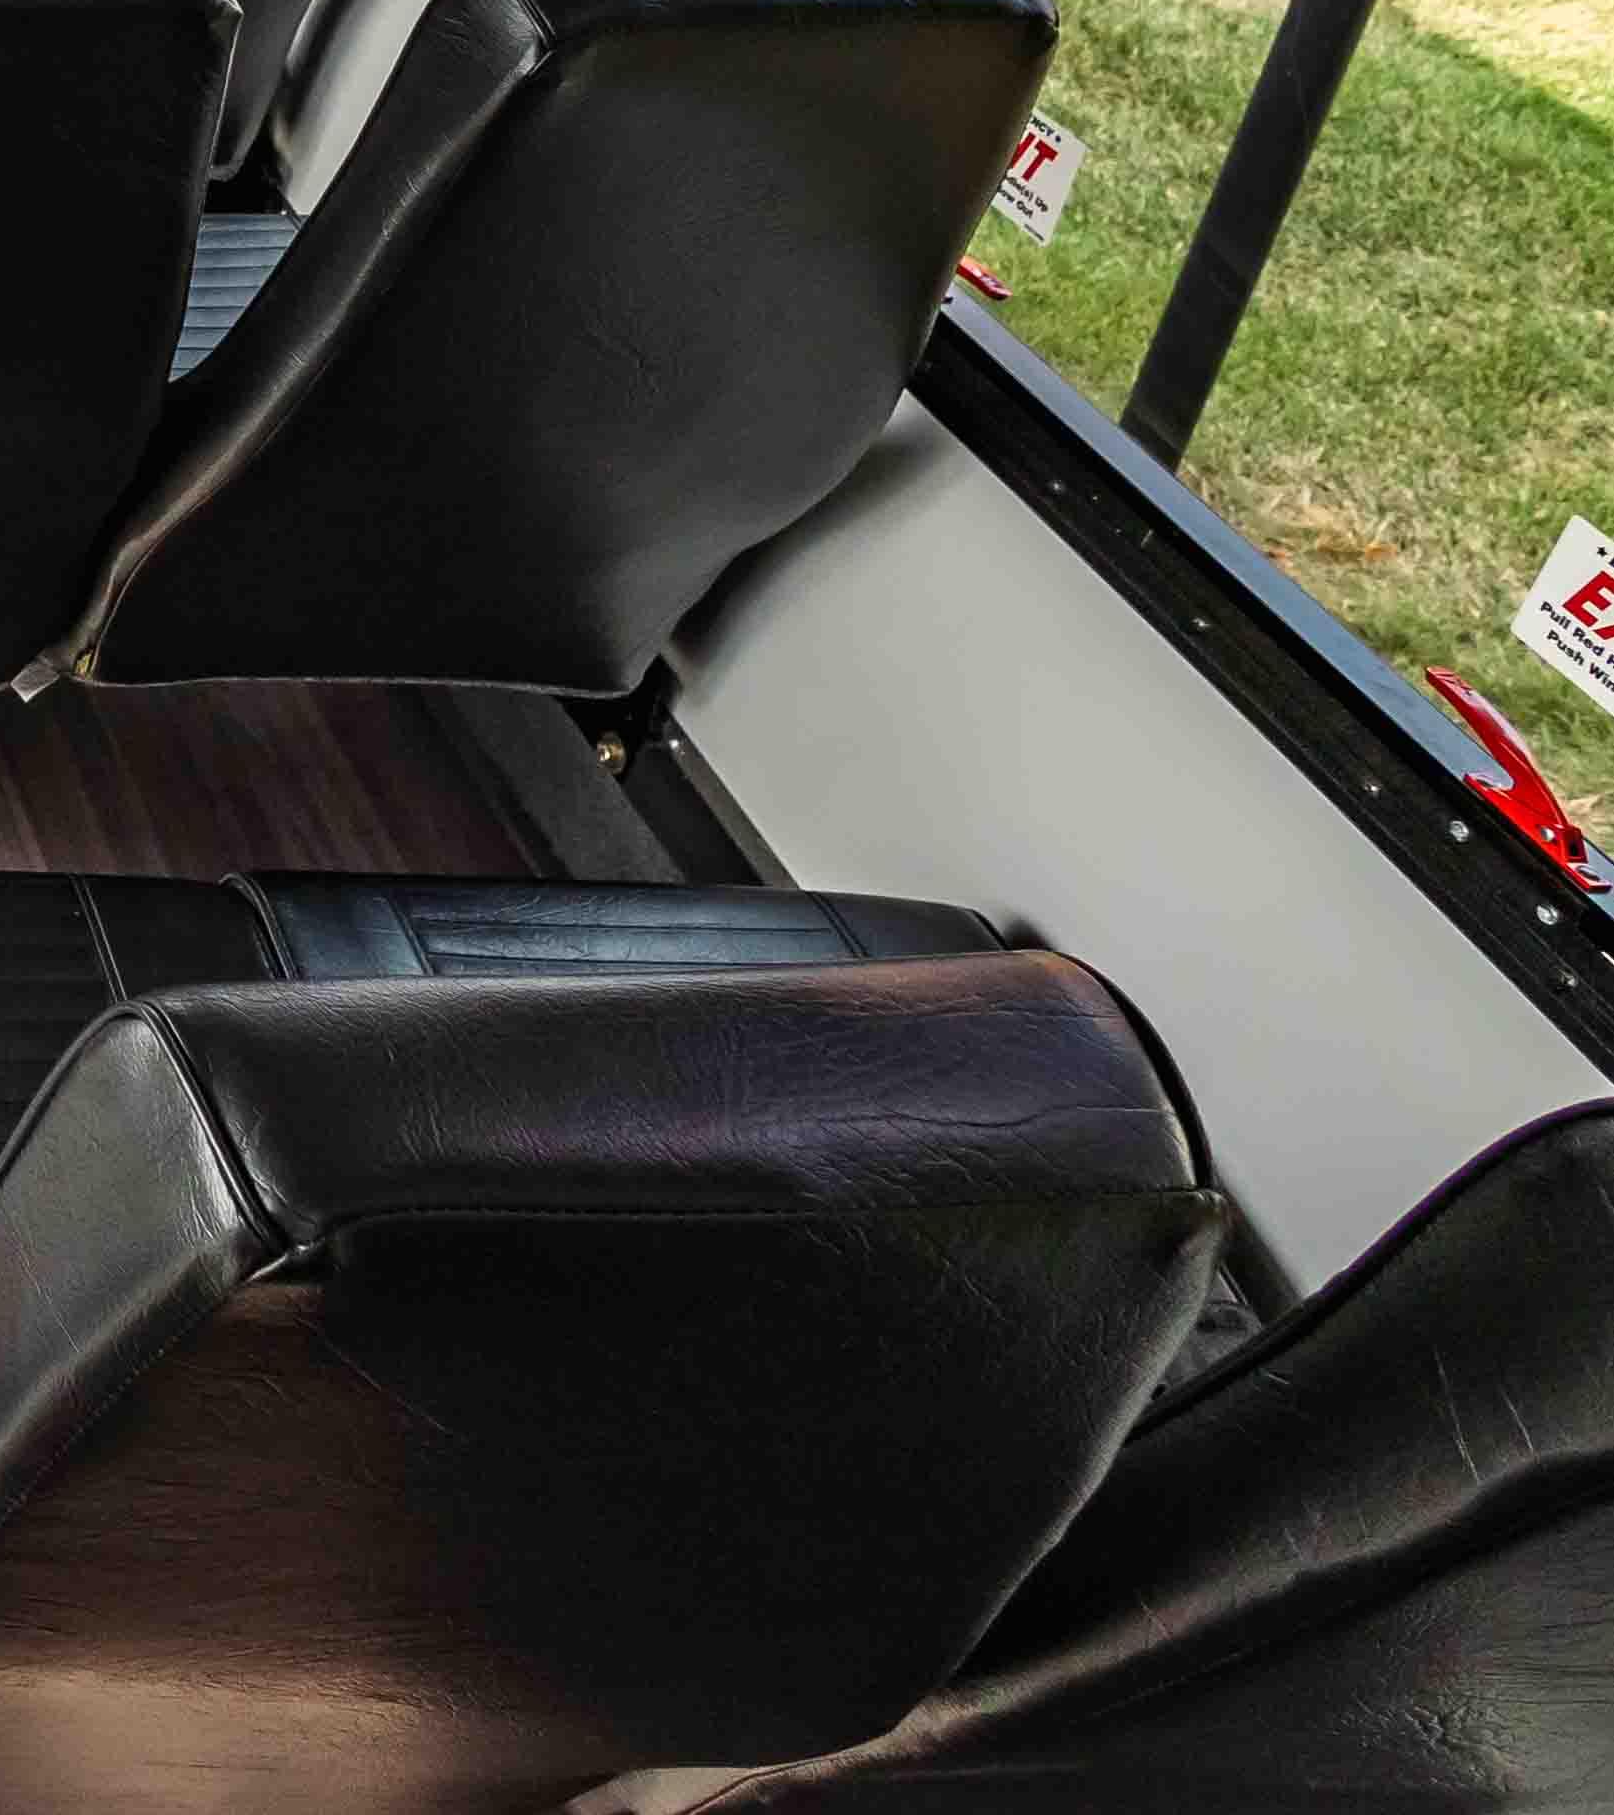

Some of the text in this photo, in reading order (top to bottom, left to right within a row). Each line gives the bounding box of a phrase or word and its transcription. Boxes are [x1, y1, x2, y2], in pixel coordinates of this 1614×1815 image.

[1540, 600, 1605, 657] Pull Red
[1546, 629, 1586, 667] Push
